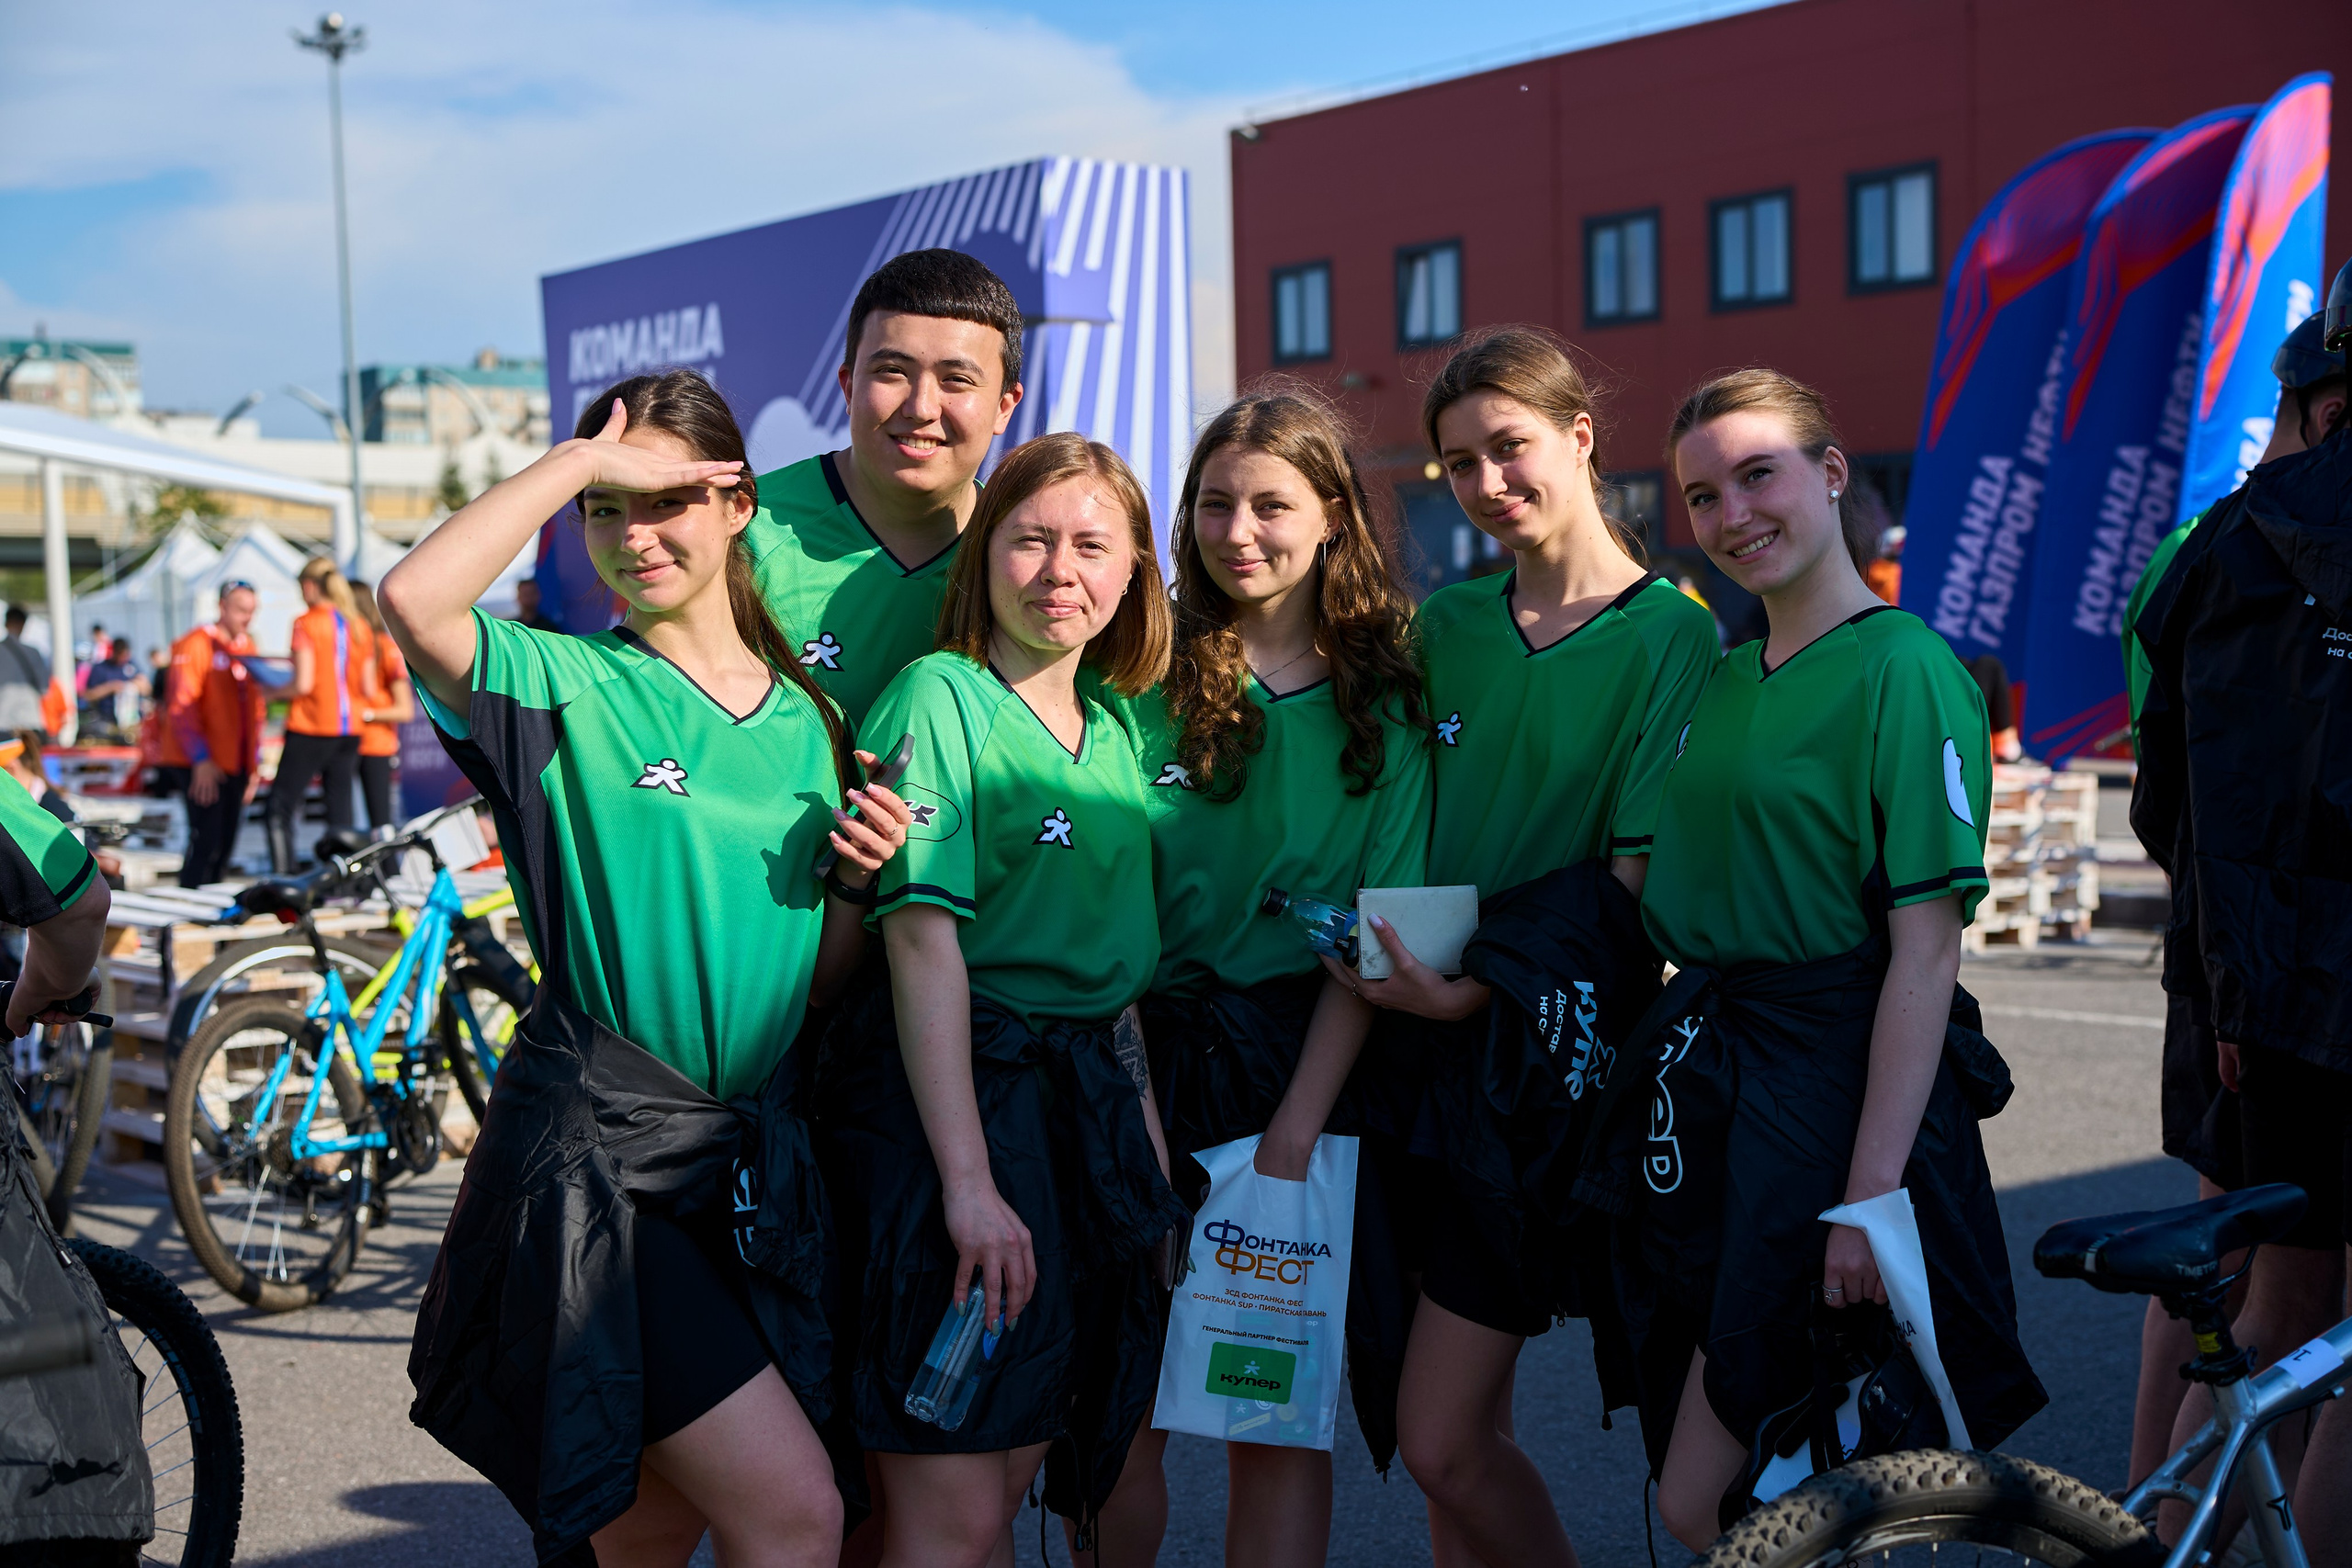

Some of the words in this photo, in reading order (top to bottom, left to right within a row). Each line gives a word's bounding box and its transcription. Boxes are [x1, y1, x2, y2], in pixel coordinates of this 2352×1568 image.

[568, 301, 725, 384] КОМАНДА
[1968, 472, 2046, 649] ГАЗПРОМ
[2021, 330, 2069, 466] НЕФ
[1932, 454, 2016, 640] КОМАНДА
[2073, 444, 2151, 637] КОМАНДА
[2327, 647, 2345, 658] на
[1540, 996, 1549, 1016] на
[1215, 1245, 1315, 1285] ФЕСТ
[1193, 1292, 1237, 1307] ФОНТАНКА
[1238, 1302, 1253, 1310] SUP
[1259, 1303, 1303, 1317] ПИРАТСКАЯ
[1225, 1288, 1240, 1298] ЗСД
[1241, 1292, 1284, 1305] ФОНТАНКА
[1202, 1325, 1247, 1337] ГЕНЕРАЛЬНЫЙ
[1247, 1333, 1276, 1342] ПАРТНЕР
[1220, 1373, 1281, 1391] купер
